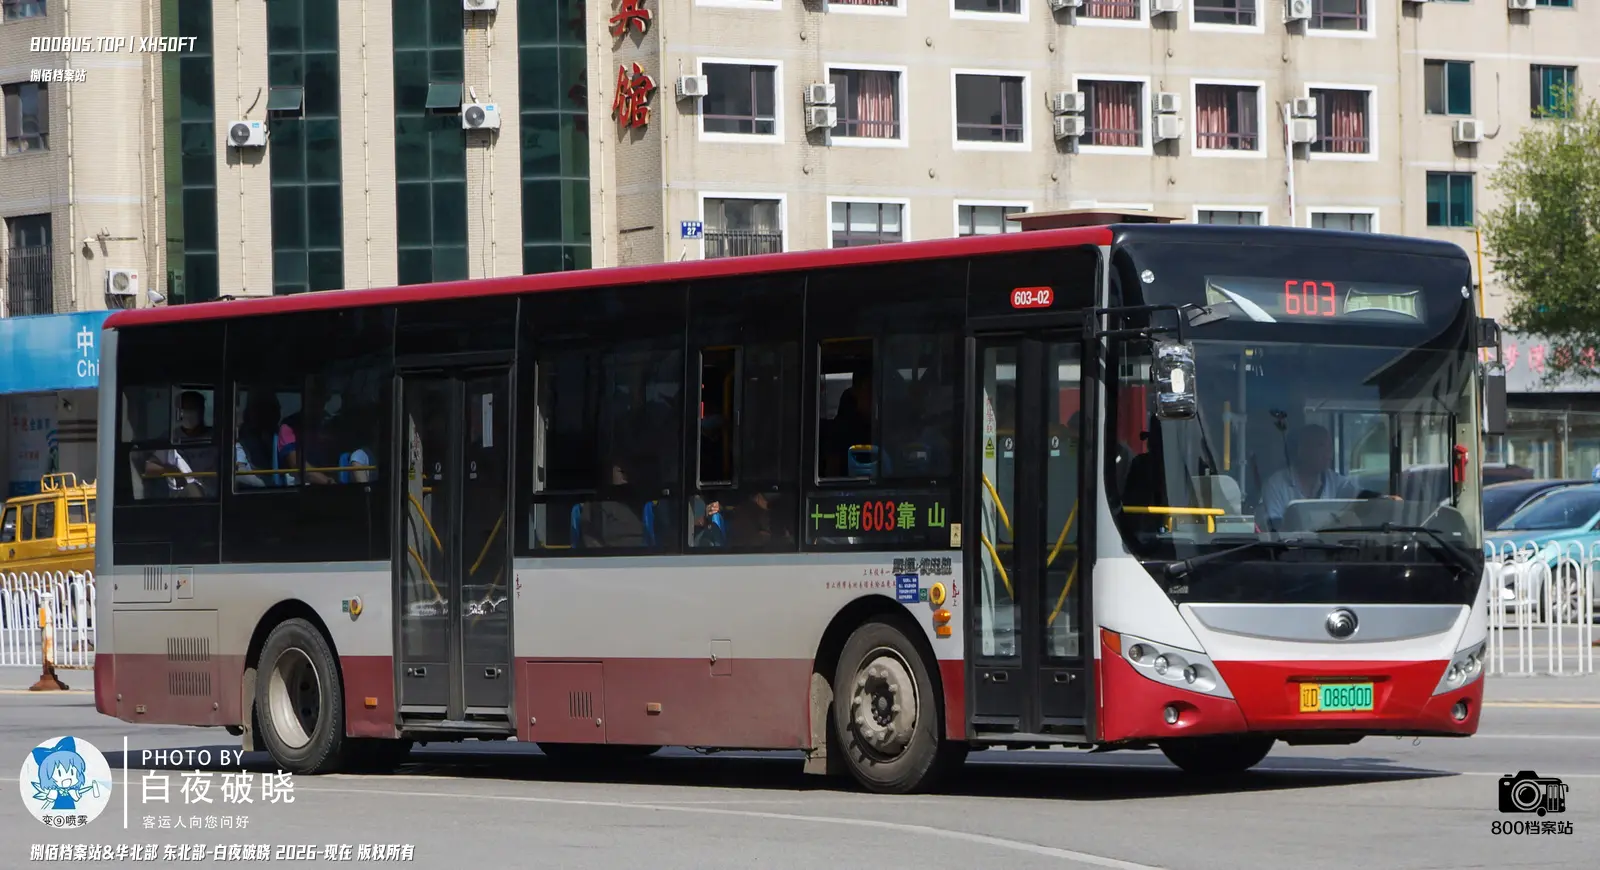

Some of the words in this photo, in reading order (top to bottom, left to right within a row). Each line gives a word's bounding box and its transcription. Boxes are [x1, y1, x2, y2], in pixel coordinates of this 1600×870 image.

[687, 227, 697, 236] 27
[1014, 290, 1050, 305] 603-02
[1285, 280, 1335, 316] 603
[77, 325, 94, 357] 中
[811, 503, 860, 530] 十一道街
[862, 501, 895, 531] 603
